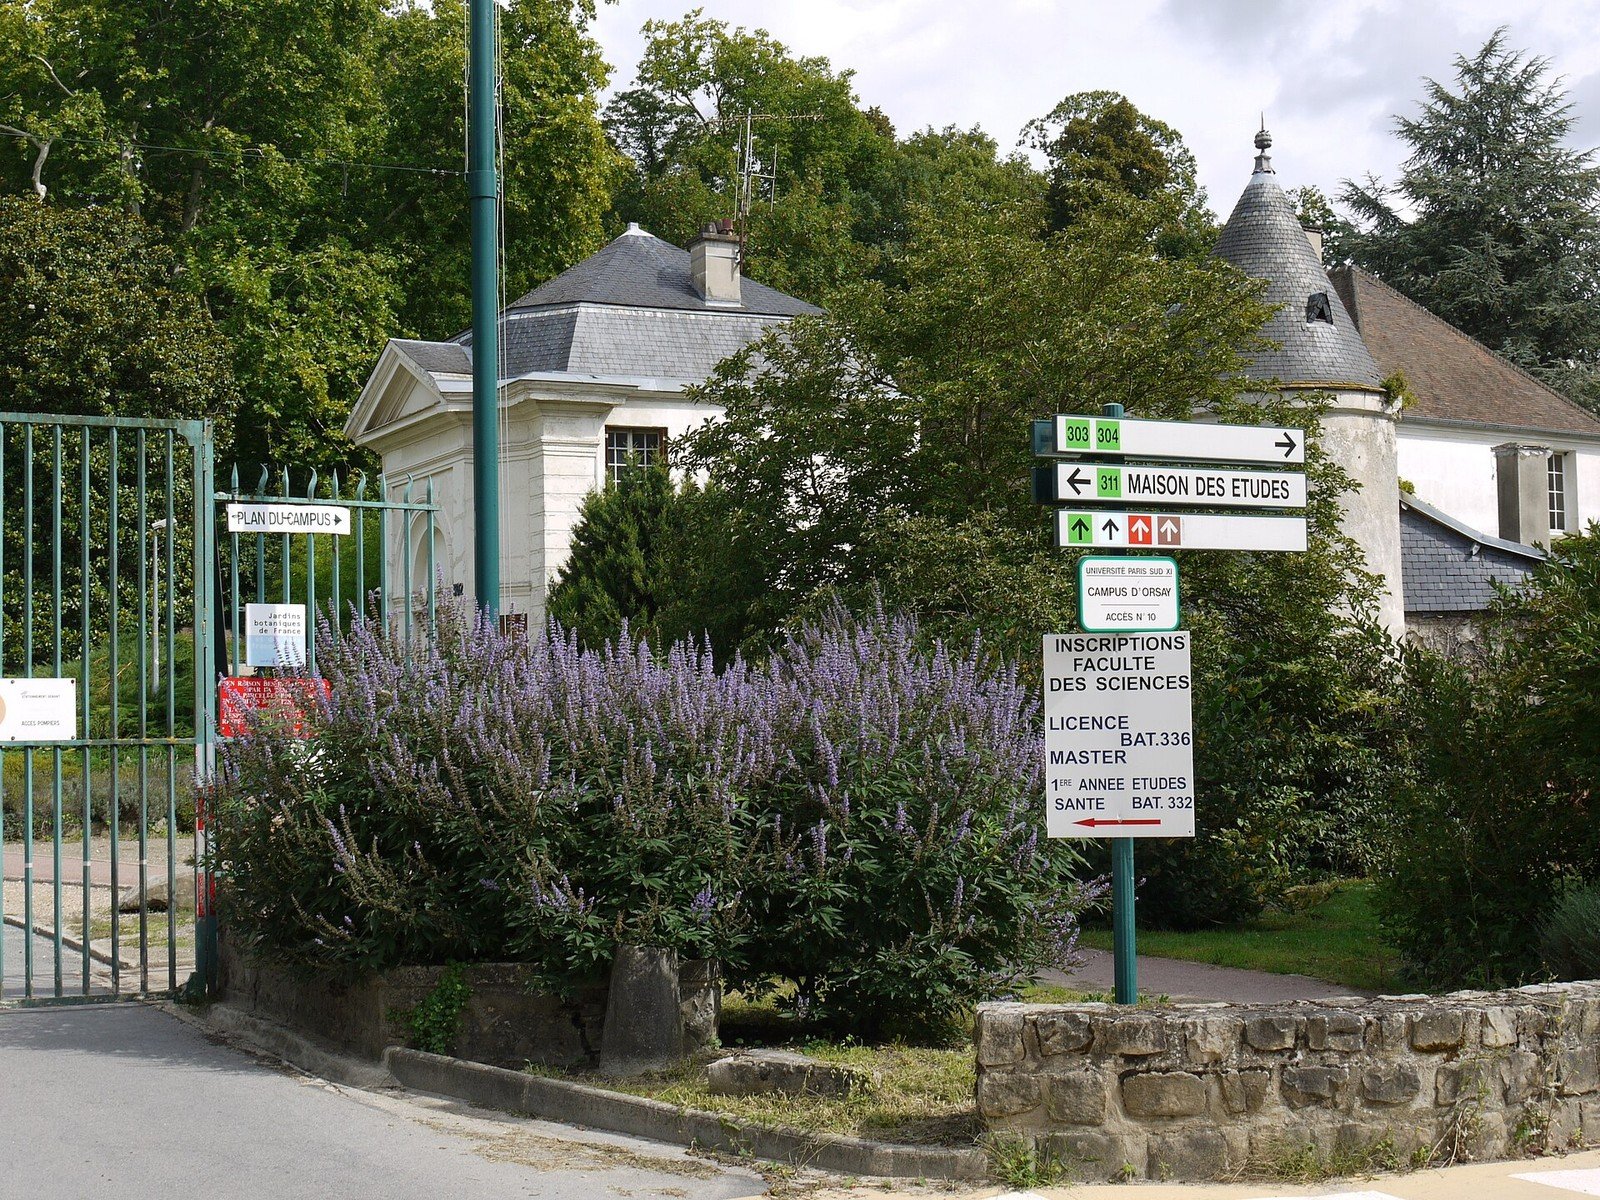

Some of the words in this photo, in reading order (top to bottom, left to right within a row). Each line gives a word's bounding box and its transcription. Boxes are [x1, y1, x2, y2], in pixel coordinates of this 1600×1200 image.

[1067, 426, 1089, 443] 303
[1097, 427, 1119, 444] 304
[1101, 475, 1119, 491] 311
[1128, 473, 1189, 496] MAISON
[1196, 476, 1225, 497] DES
[1232, 478, 1290, 499] ETUDES
[237, 511, 266, 525] PLAN
[269, 511, 284, 525] DU
[286, 512, 331, 526] CAMPUS
[1128, 567, 1147, 575] PARIS
[1087, 587, 1128, 597] CAMPUS
[253, 619, 301, 627] botaniques
[1148, 612, 1156, 621] 10
[1055, 636, 1186, 653] INSCRIPTIONS
[1073, 656, 1156, 672] FACULTE
[1050, 677, 1087, 692] DES
[1096, 675, 1190, 691] SCIENCES
[1050, 715, 1129, 731] LICENCE
[1121, 732, 1191, 747] BAT.336
[1050, 750, 1127, 765] MASTER
[1078, 778, 1125, 791] ANNEE
[1132, 777, 1187, 790] ETUDES
[1055, 797, 1105, 811] SANTE
[1132, 797, 1164, 809] BAT.
[1168, 796, 1193, 809] 332
